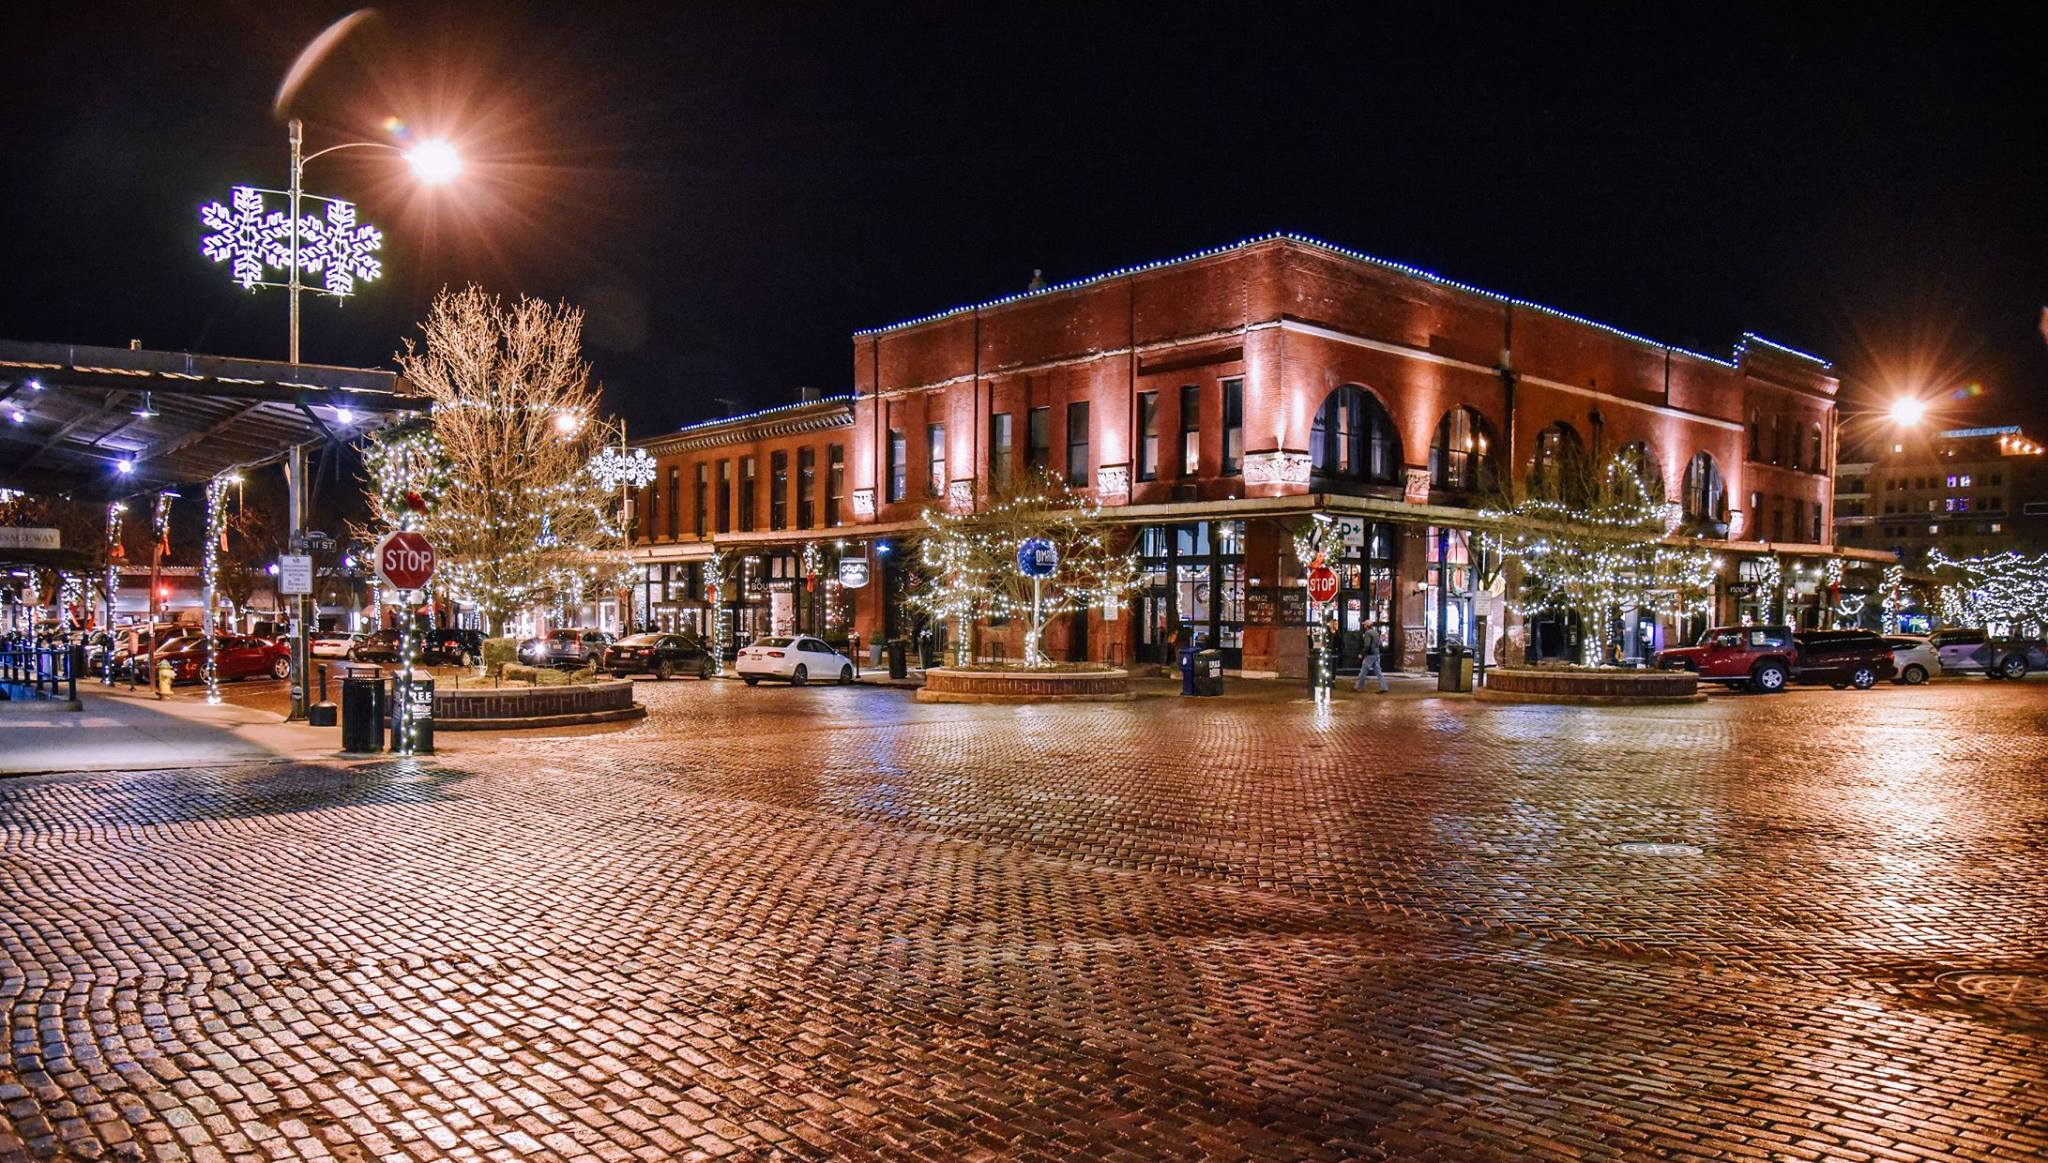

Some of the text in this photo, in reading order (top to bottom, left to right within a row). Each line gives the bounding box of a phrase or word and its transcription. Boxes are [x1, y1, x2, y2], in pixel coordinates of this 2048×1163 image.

[322, 541, 333, 549] ST
[385, 549, 431, 572] STOP
[1309, 578, 1335, 591] STOP
[409, 692, 432, 701] REE
